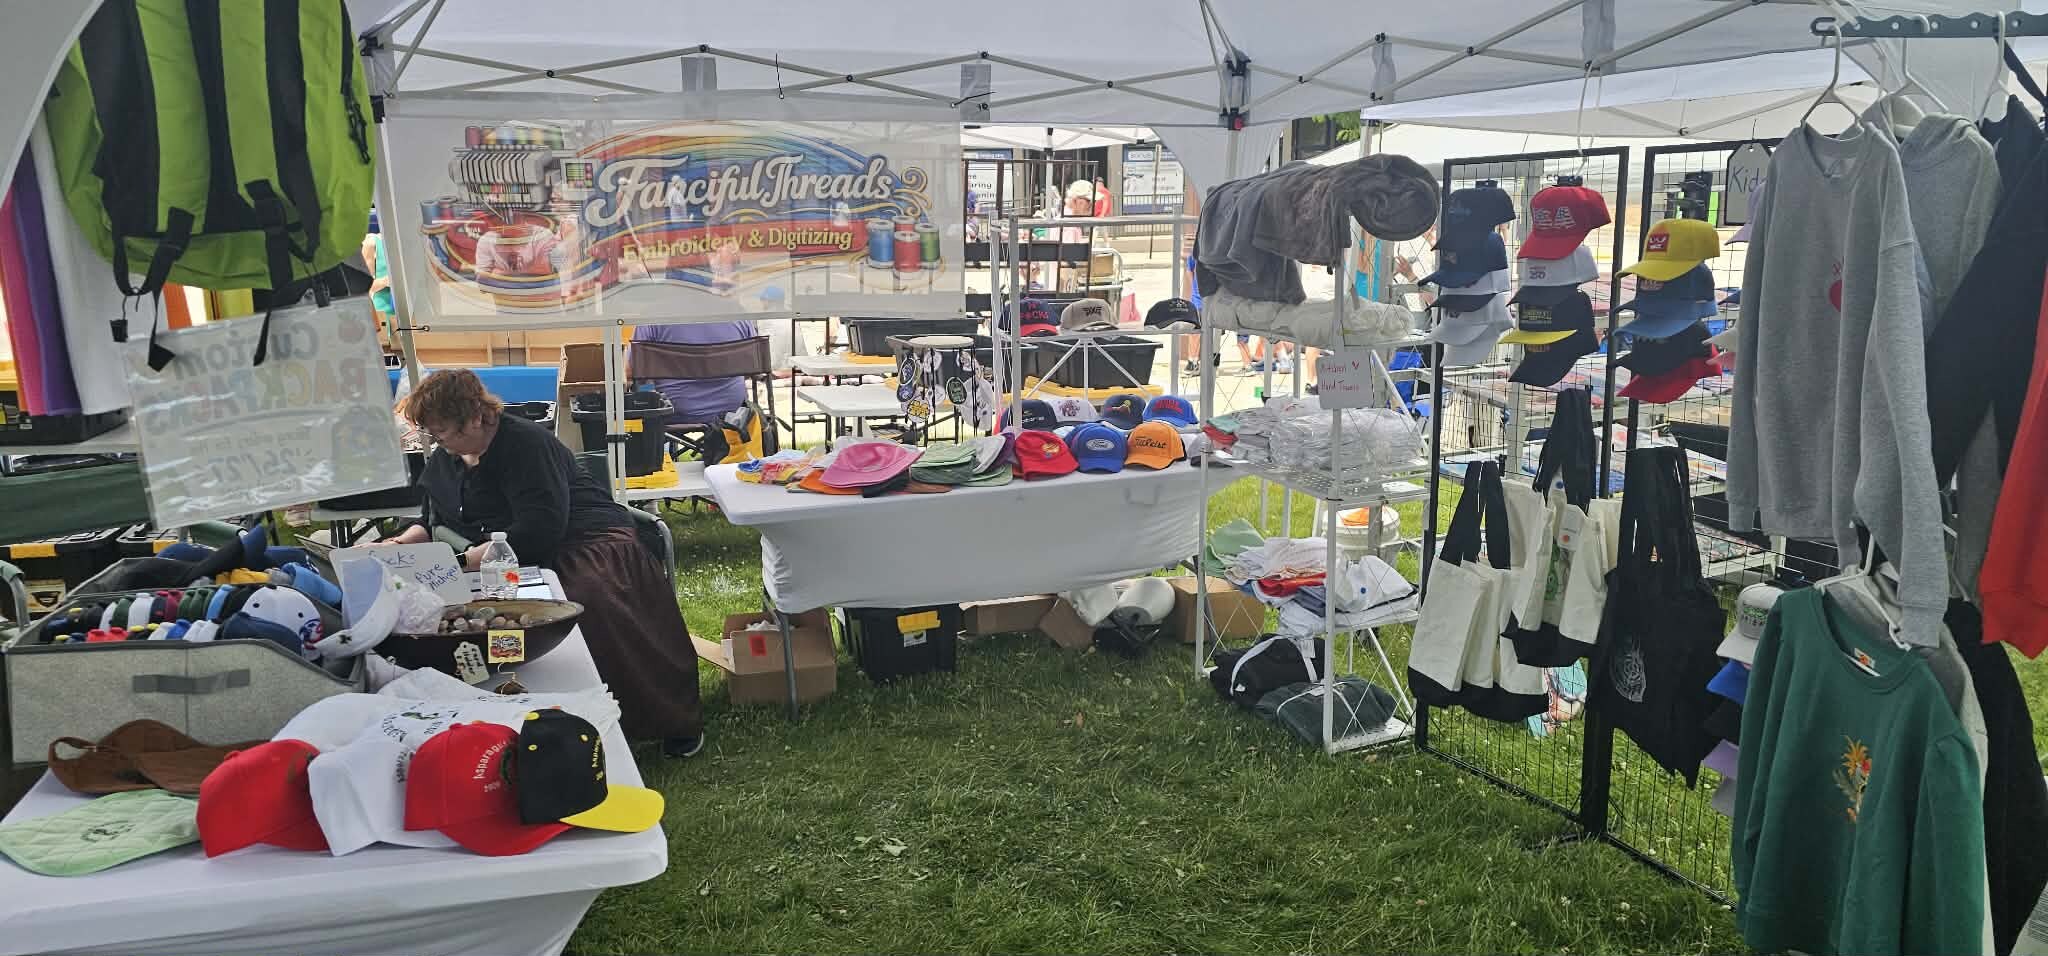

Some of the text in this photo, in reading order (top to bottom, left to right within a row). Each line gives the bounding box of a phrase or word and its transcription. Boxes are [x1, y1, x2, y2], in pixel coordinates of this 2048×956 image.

[585, 154, 893, 228] Fanciful Threads
[622, 226, 853, 263] Embroidery & Digitizing
[1135, 435, 1167, 449] Titleist
[415, 563, 444, 584] Pure
